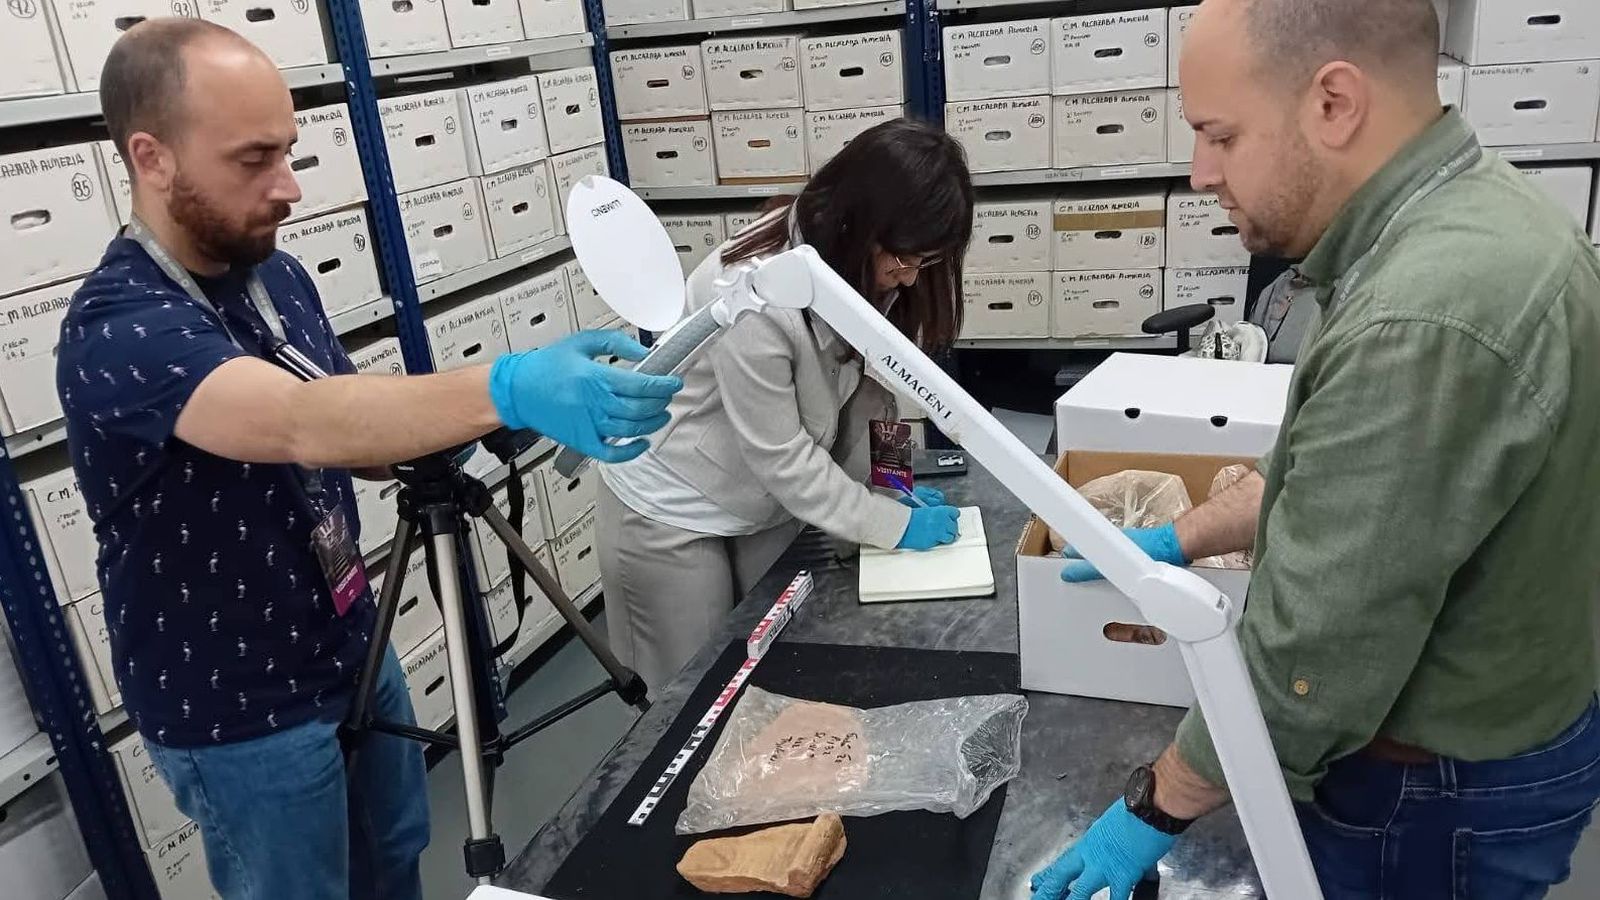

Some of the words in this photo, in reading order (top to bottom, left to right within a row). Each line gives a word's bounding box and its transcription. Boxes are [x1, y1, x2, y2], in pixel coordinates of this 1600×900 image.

[1081, 18, 1116, 28] ALCAZABA
[968, 28, 1003, 38] ALCAZABA
[1081, 96, 1118, 104] ALCAZABA
[40, 153, 86, 172] ALMERIA
[73, 179, 91, 198] 85
[1111, 201, 1140, 210] ALMERIA
[301, 221, 334, 236] ALCAZABA
[1195, 268, 1235, 277] ALCAZABA
[880, 354, 945, 413] ALMACÉN
[944, 409, 953, 419] I
